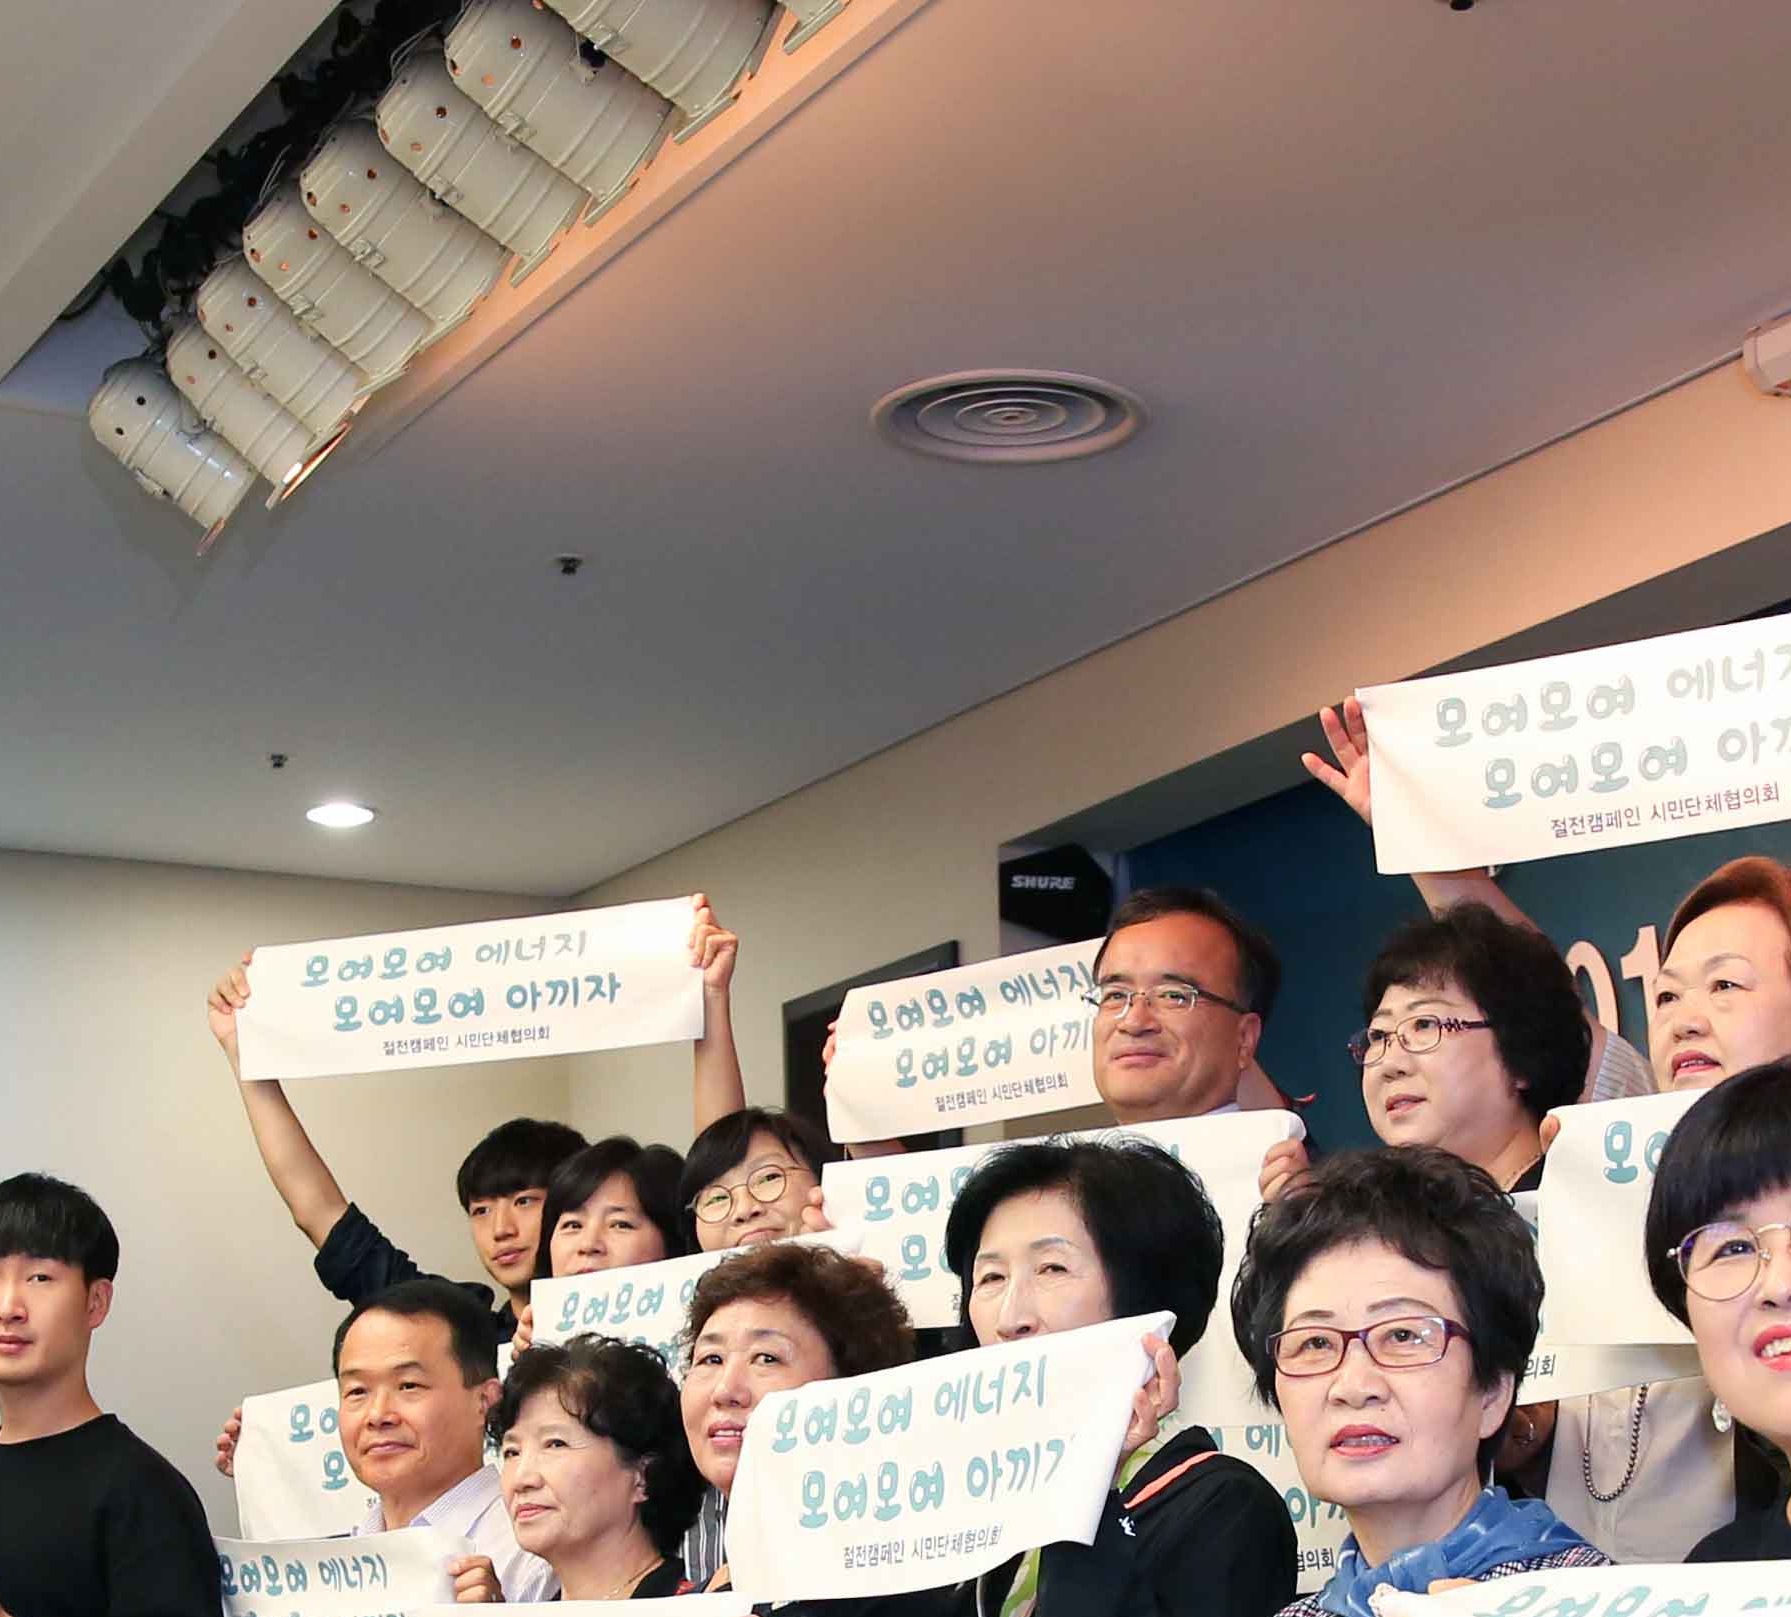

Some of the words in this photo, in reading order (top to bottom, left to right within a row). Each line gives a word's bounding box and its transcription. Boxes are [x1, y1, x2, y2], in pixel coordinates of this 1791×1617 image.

[1434, 674, 1636, 749] 모여모여
[1483, 736, 1689, 811] 모여모여
[1551, 807, 1640, 838] 절전캠페인
[1649, 780, 1781, 823] 시민단체협의회
[1011, 875, 1075, 889] SHURE
[301, 946, 452, 987] 모여모여
[475, 930, 586, 965] 에너지
[334, 988, 484, 1032] 모여모여
[506, 973, 621, 1012] 아끼자
[868, 985, 986, 1039] 모여모여
[999, 960, 1097, 1008] 에너지
[383, 1036, 449, 1056] 절전캠페인
[457, 1025, 549, 1048] 시민단체협의회
[895, 1034, 1012, 1089] 모여모여
[1029, 1015, 1093, 1057] 아끼
[935, 1088, 987, 1112] 절전캠페인
[992, 1072, 1068, 1101] 시민단체협의회
[556, 1283, 664, 1332] 모여모여
[771, 1387, 913, 1453] 모여모여
[934, 1354, 1045, 1421] 에너지
[799, 1461, 945, 1529] 모여모여
[220, 1554, 307, 1595] 모여모여
[318, 1553, 387, 1592] 에너지
[844, 1540, 904, 1568] 절전캠페인
[911, 1522, 1002, 1561] 시민단체협의회
